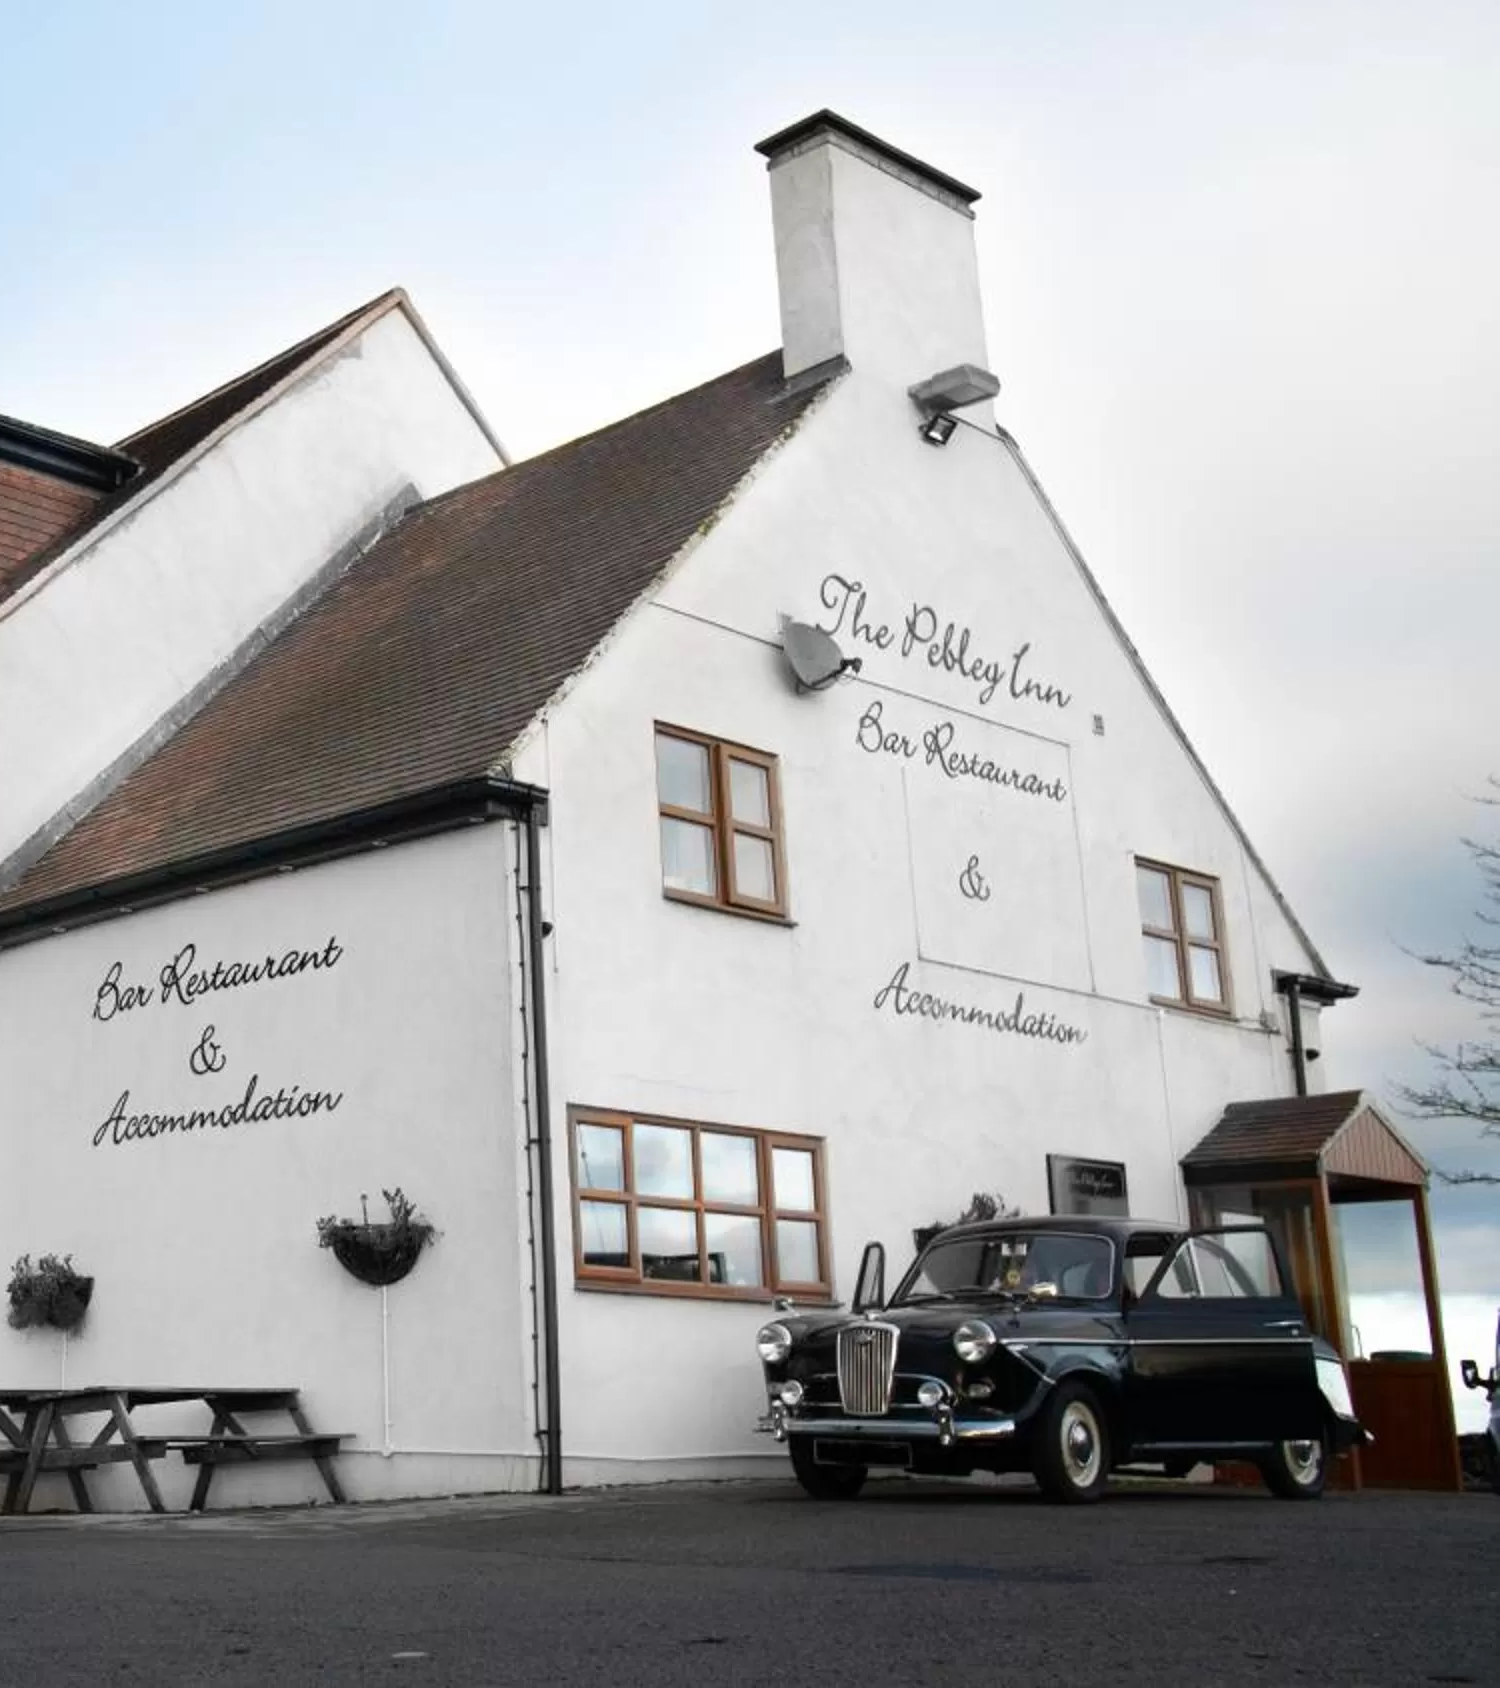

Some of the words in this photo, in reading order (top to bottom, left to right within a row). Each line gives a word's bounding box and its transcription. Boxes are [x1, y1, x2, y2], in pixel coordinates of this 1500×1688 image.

[815, 573, 894, 651] The
[901, 603, 1008, 705] Pebley
[1009, 643, 1072, 709] Inn
[855, 701, 917, 760] Bar
[923, 722, 1068, 802] Restaurant
[958, 854, 991, 901] &
[93, 961, 155, 1021] Bar
[159, 936, 344, 1005] Restaurant
[872, 962, 1088, 1045] Accommodation
[189, 1024, 226, 1075] &
[92, 1073, 344, 1147] Accommodation
